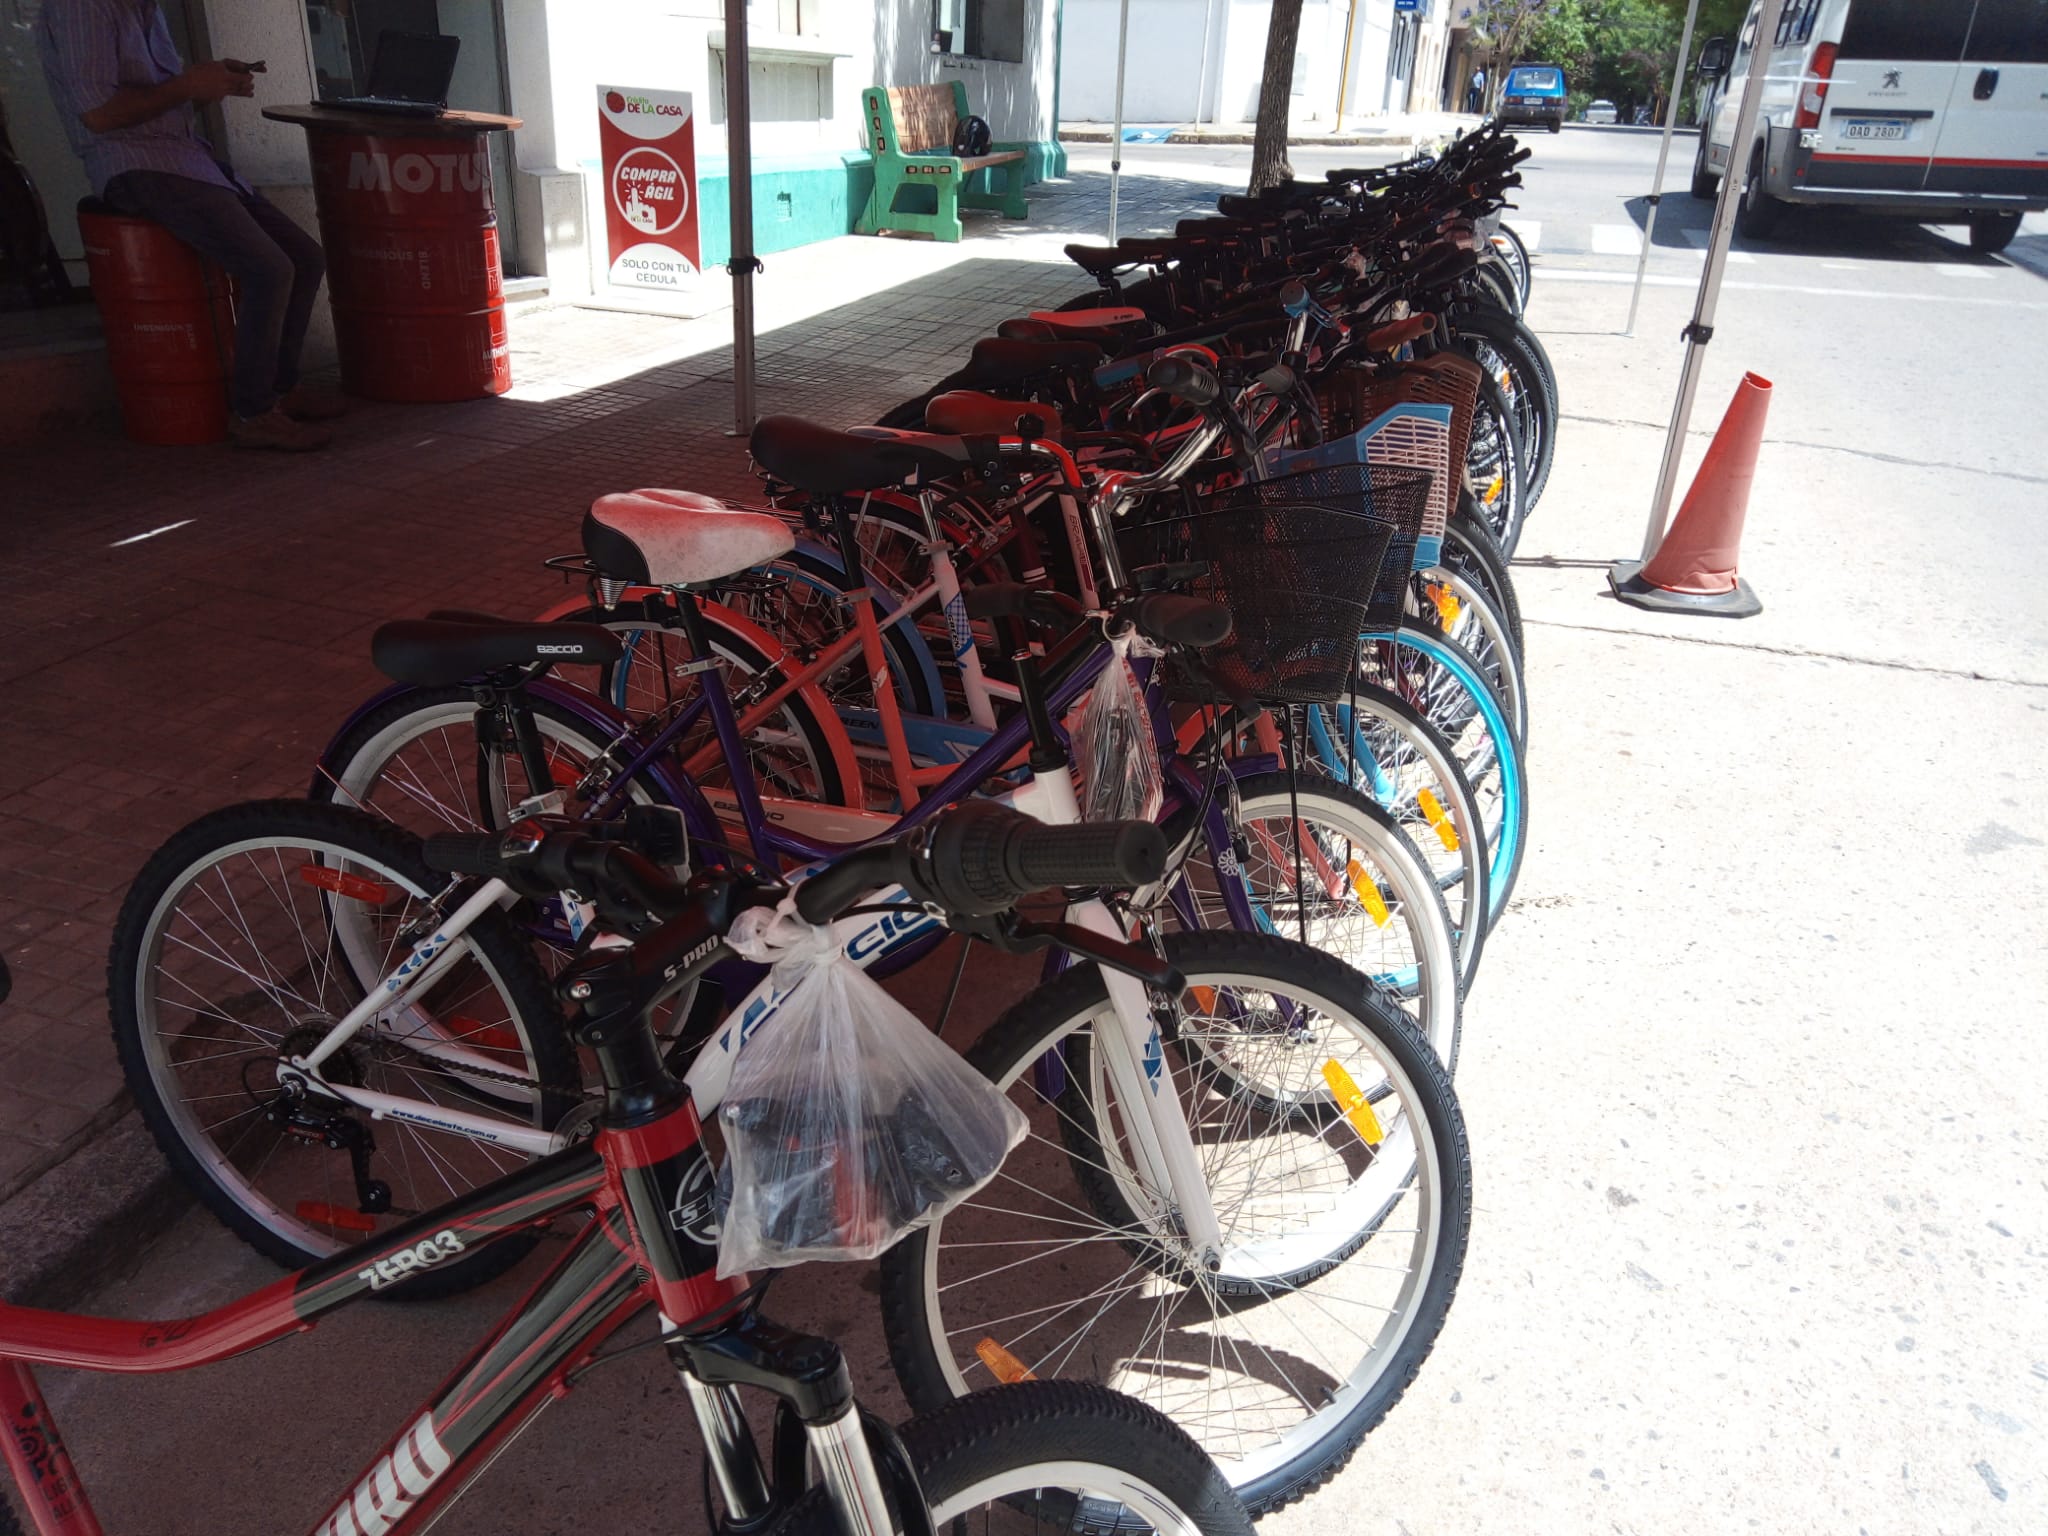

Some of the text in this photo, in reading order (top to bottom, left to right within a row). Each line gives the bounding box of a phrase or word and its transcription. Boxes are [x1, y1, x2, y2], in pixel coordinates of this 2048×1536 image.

[627, 103, 683, 117] DE LA CASA
[620, 167, 677, 184] COMPRA
[644, 182, 675, 201] ÁGIL
[621, 258, 690, 274] SOLO CON TU
[636, 272, 678, 285] CEDULA
[663, 934, 719, 983] S-PRO
[358, 1229, 465, 1291] ZERO3
